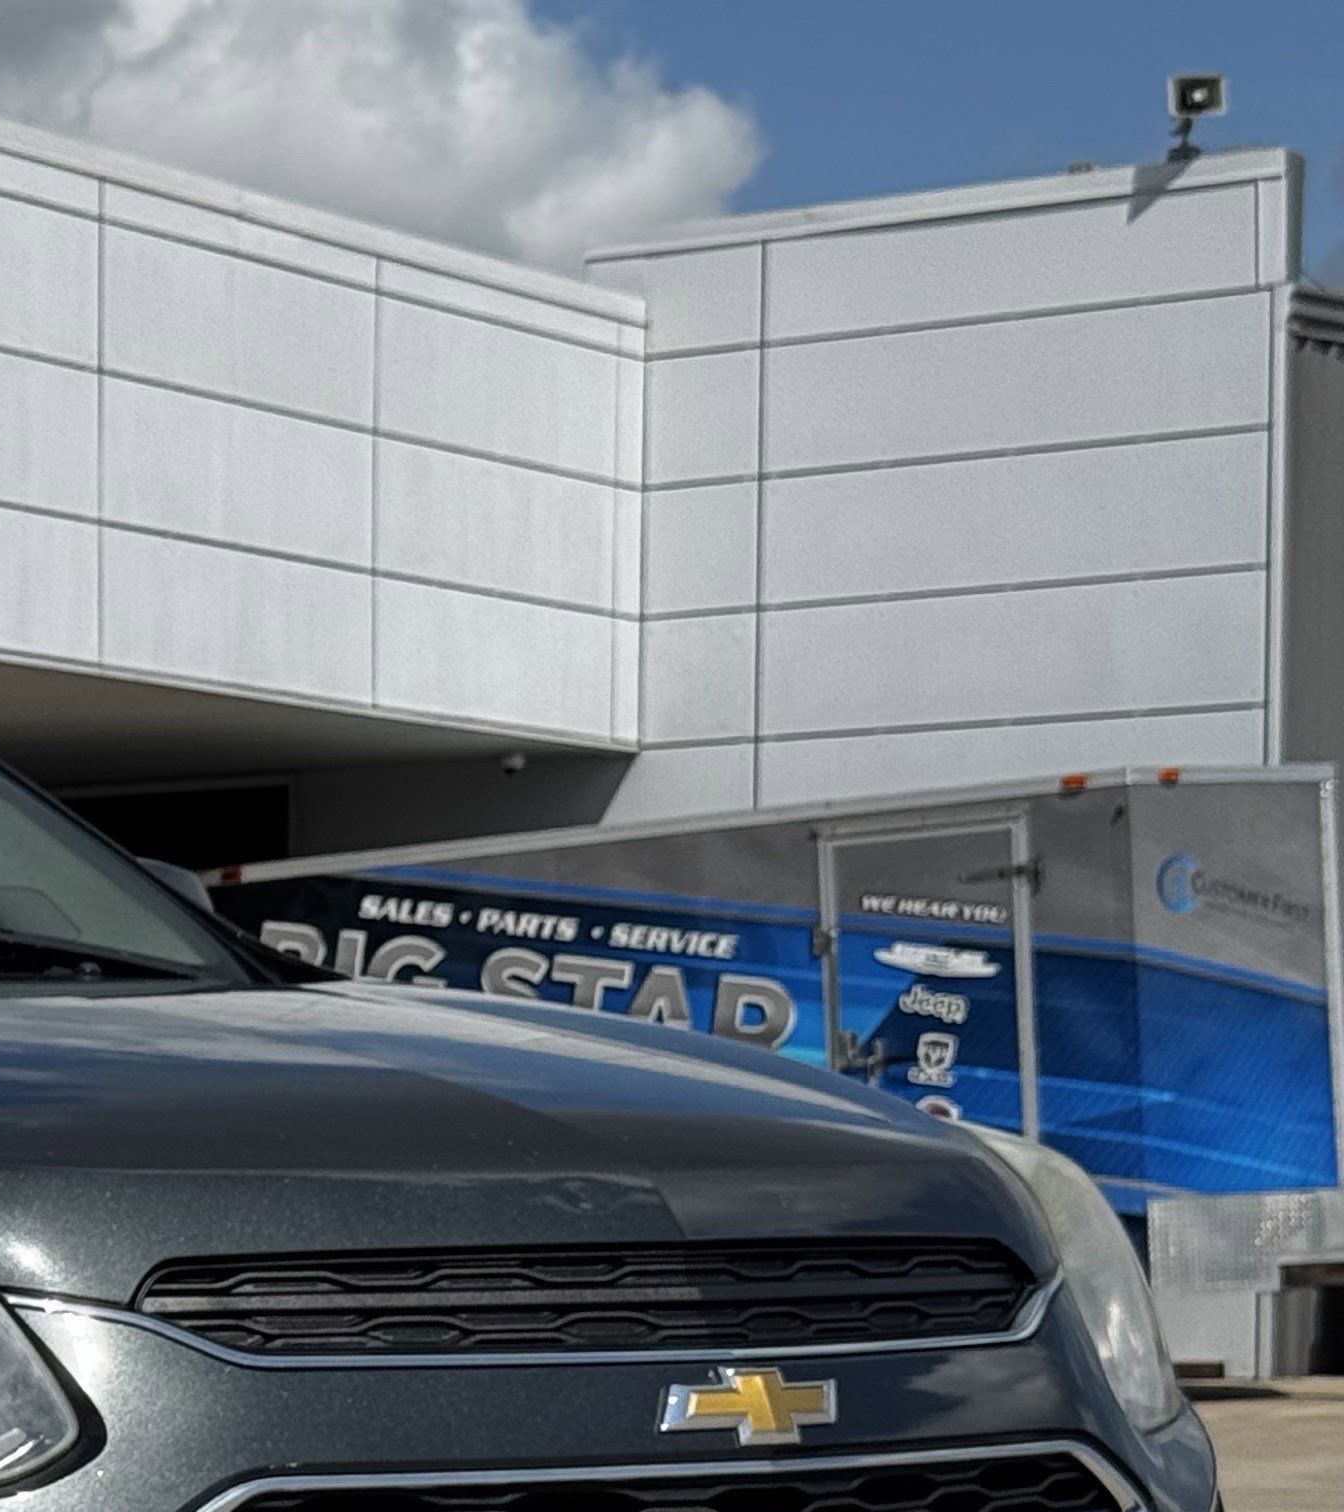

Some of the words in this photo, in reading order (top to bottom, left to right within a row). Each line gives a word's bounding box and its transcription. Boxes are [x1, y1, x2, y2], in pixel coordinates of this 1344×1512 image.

[358, 894, 455, 928] SALES
[476, 907, 580, 942] PARTS
[608, 922, 741, 960] SERVICE
[899, 983, 970, 1024] Jeep
